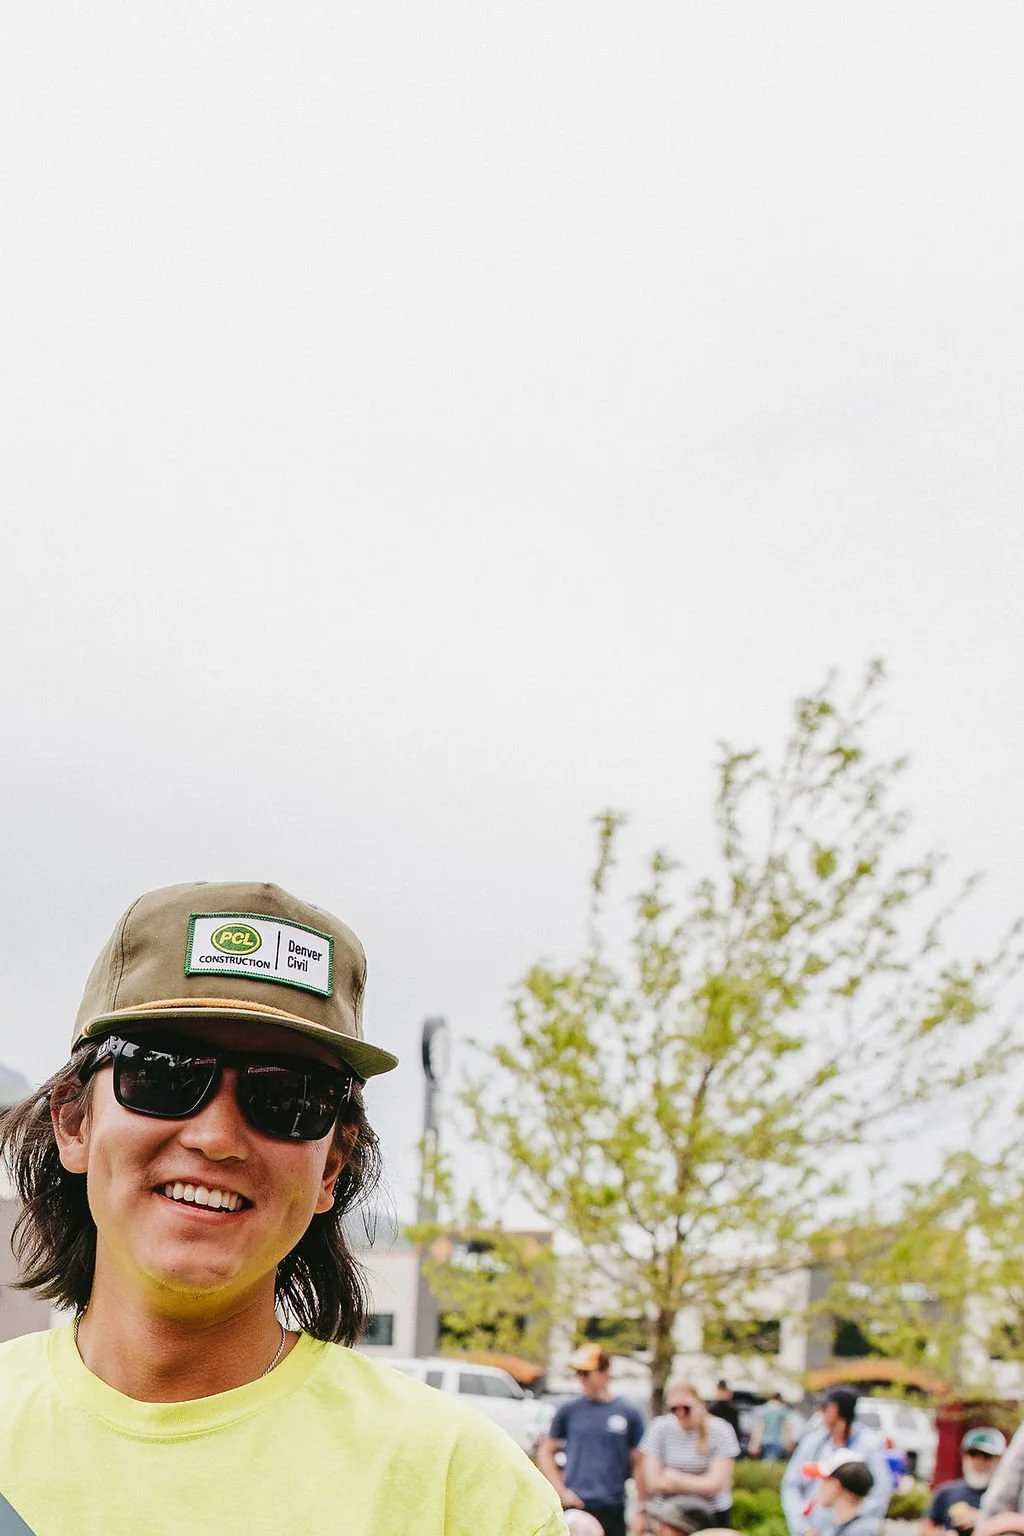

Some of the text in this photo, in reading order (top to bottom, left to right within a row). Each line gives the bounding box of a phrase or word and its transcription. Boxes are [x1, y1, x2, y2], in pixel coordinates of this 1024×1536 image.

[219, 932, 253, 945] PCL
[288, 939, 323, 962] Denver
[199, 955, 271, 969] CONSTRUCTION
[287, 956, 308, 972] Civil
